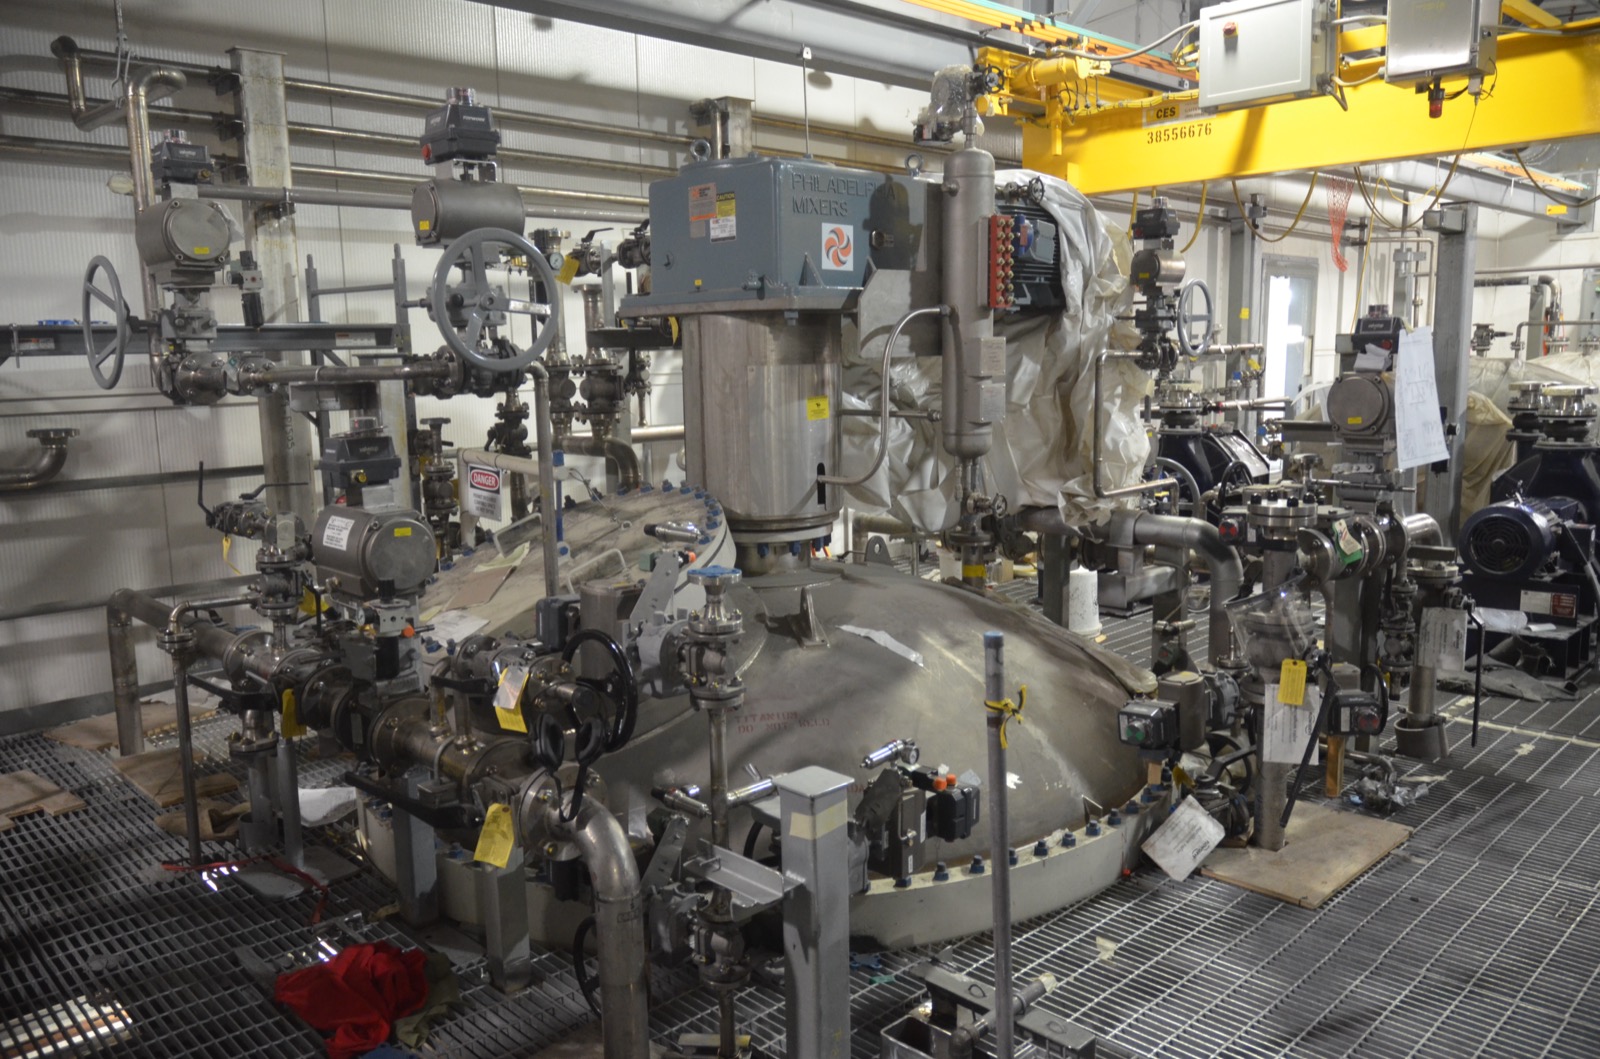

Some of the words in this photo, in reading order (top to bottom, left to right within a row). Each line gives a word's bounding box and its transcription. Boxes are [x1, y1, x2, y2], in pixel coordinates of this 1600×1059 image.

[1156, 107, 1176, 119] CES
[1147, 123, 1212, 144] 38556676
[792, 196, 848, 217] MIXERS
[473, 473, 496, 487] DANGER
[737, 724, 754, 734] DO
[765, 721, 789, 732] NOT
